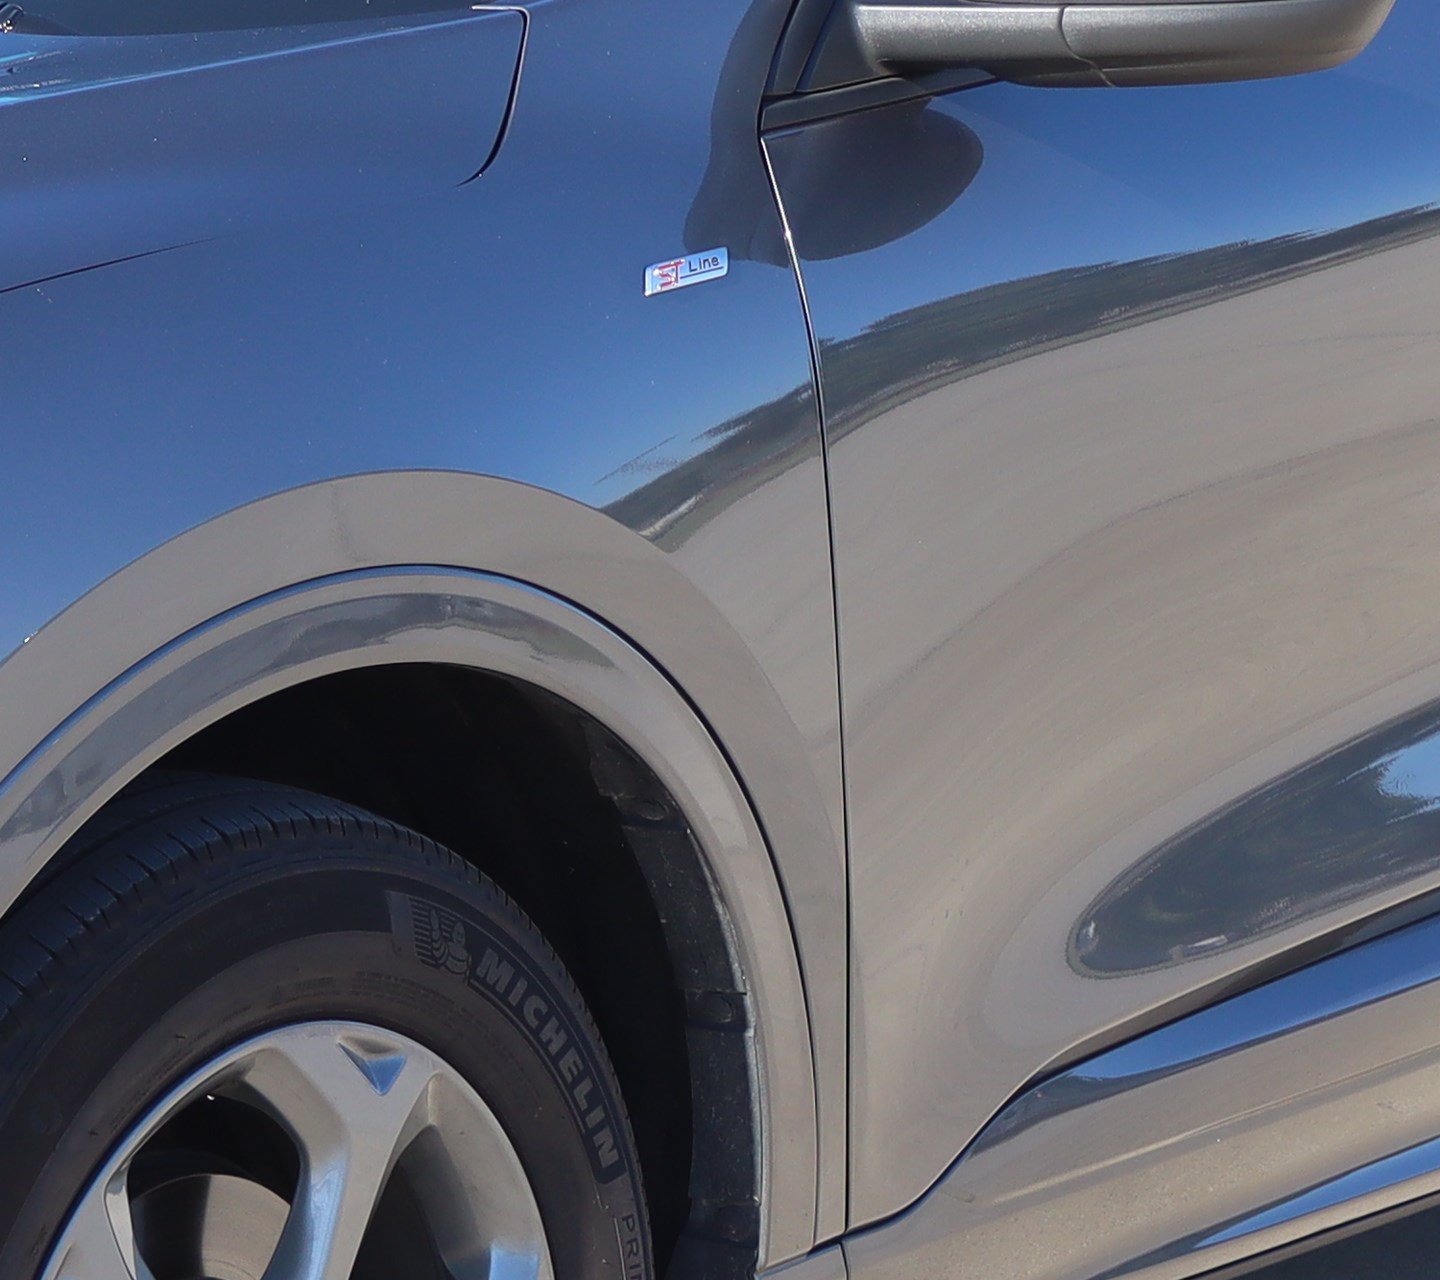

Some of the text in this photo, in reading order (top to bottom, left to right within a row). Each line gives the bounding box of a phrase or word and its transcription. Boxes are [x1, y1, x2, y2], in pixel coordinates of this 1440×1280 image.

[654, 255, 720, 291] ST Line
[476, 947, 620, 1170] MICHELIN
